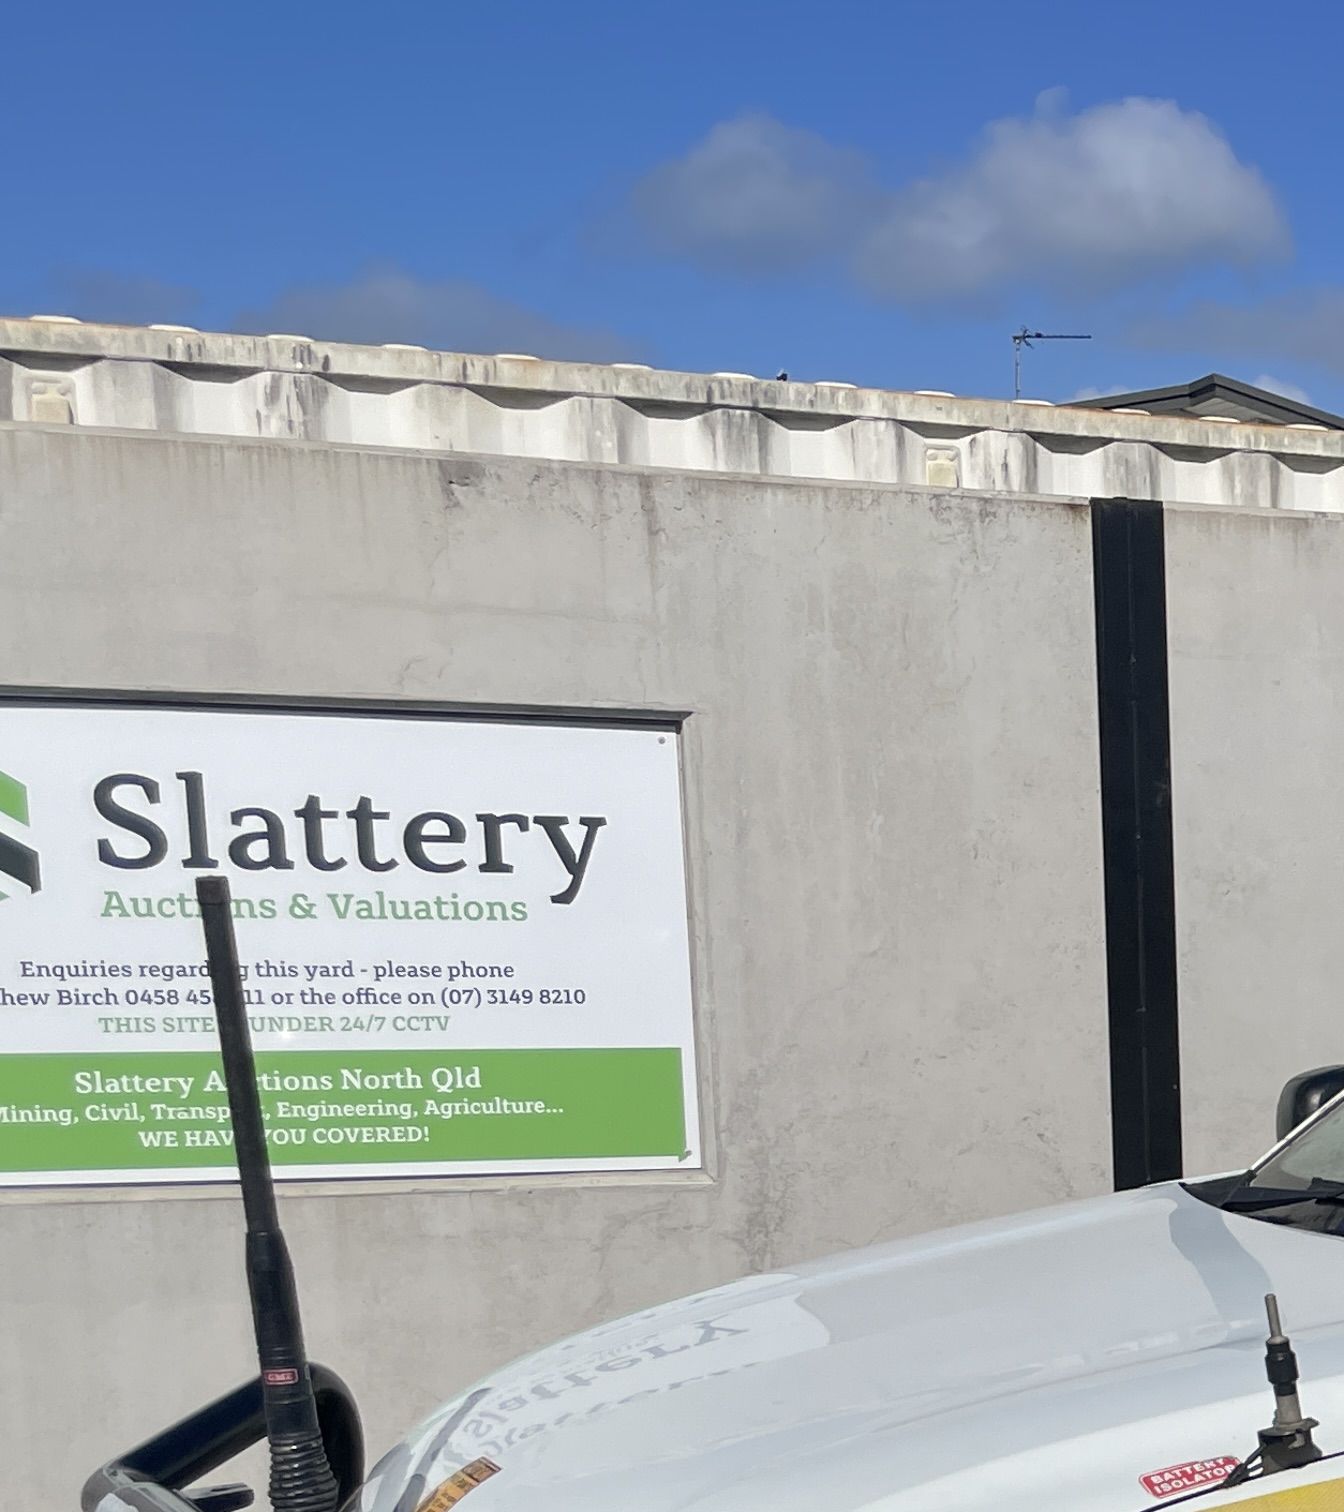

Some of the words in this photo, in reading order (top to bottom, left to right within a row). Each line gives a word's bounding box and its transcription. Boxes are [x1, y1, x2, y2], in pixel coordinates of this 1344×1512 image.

[93, 771, 607, 904] Slattery
[100, 890, 277, 919] Auctns
[288, 892, 318, 919] &
[327, 890, 529, 922] Valuations
[20, 960, 132, 981] Enquiries
[139, 960, 249, 981] regardg
[255, 960, 299, 978] this
[304, 960, 355, 981] yard
[373, 960, 442, 981] please
[448, 961, 514, 981] phone
[57, 988, 119, 1006] Birch
[125, 989, 180, 1006] 0458
[186, 989, 214, 1006] 45
[271, 992, 294, 1005] or
[300, 987, 336, 1005] the
[342, 987, 402, 1005] office
[408, 991, 434, 1005] on
[441, 987, 482, 1008] (07)
[487, 988, 533, 1005] 3149
[539, 988, 586, 1005] 8210
[99, 1017, 156, 1033] THIS
[162, 1016, 215, 1033] SITE
[251, 1015, 335, 1032] UNDER
[340, 1014, 386, 1032] 24/7
[392, 1015, 450, 1032] CCTV
[74, 1071, 194, 1099] Slattery
[203, 1069, 333, 1092] Ations
[341, 1067, 423, 1091] North
[432, 1066, 481, 1093] Qld
[85, 1102, 146, 1122] Civil,
[277, 1099, 418, 1121] Engineering,
[424, 1097, 564, 1119] Agriculture...
[138, 1131, 178, 1147] WE
[185, 1130, 235, 1147] HAV
[312, 1126, 429, 1145] COVERED!
[1150, 1458, 1225, 1485] BATTERY
